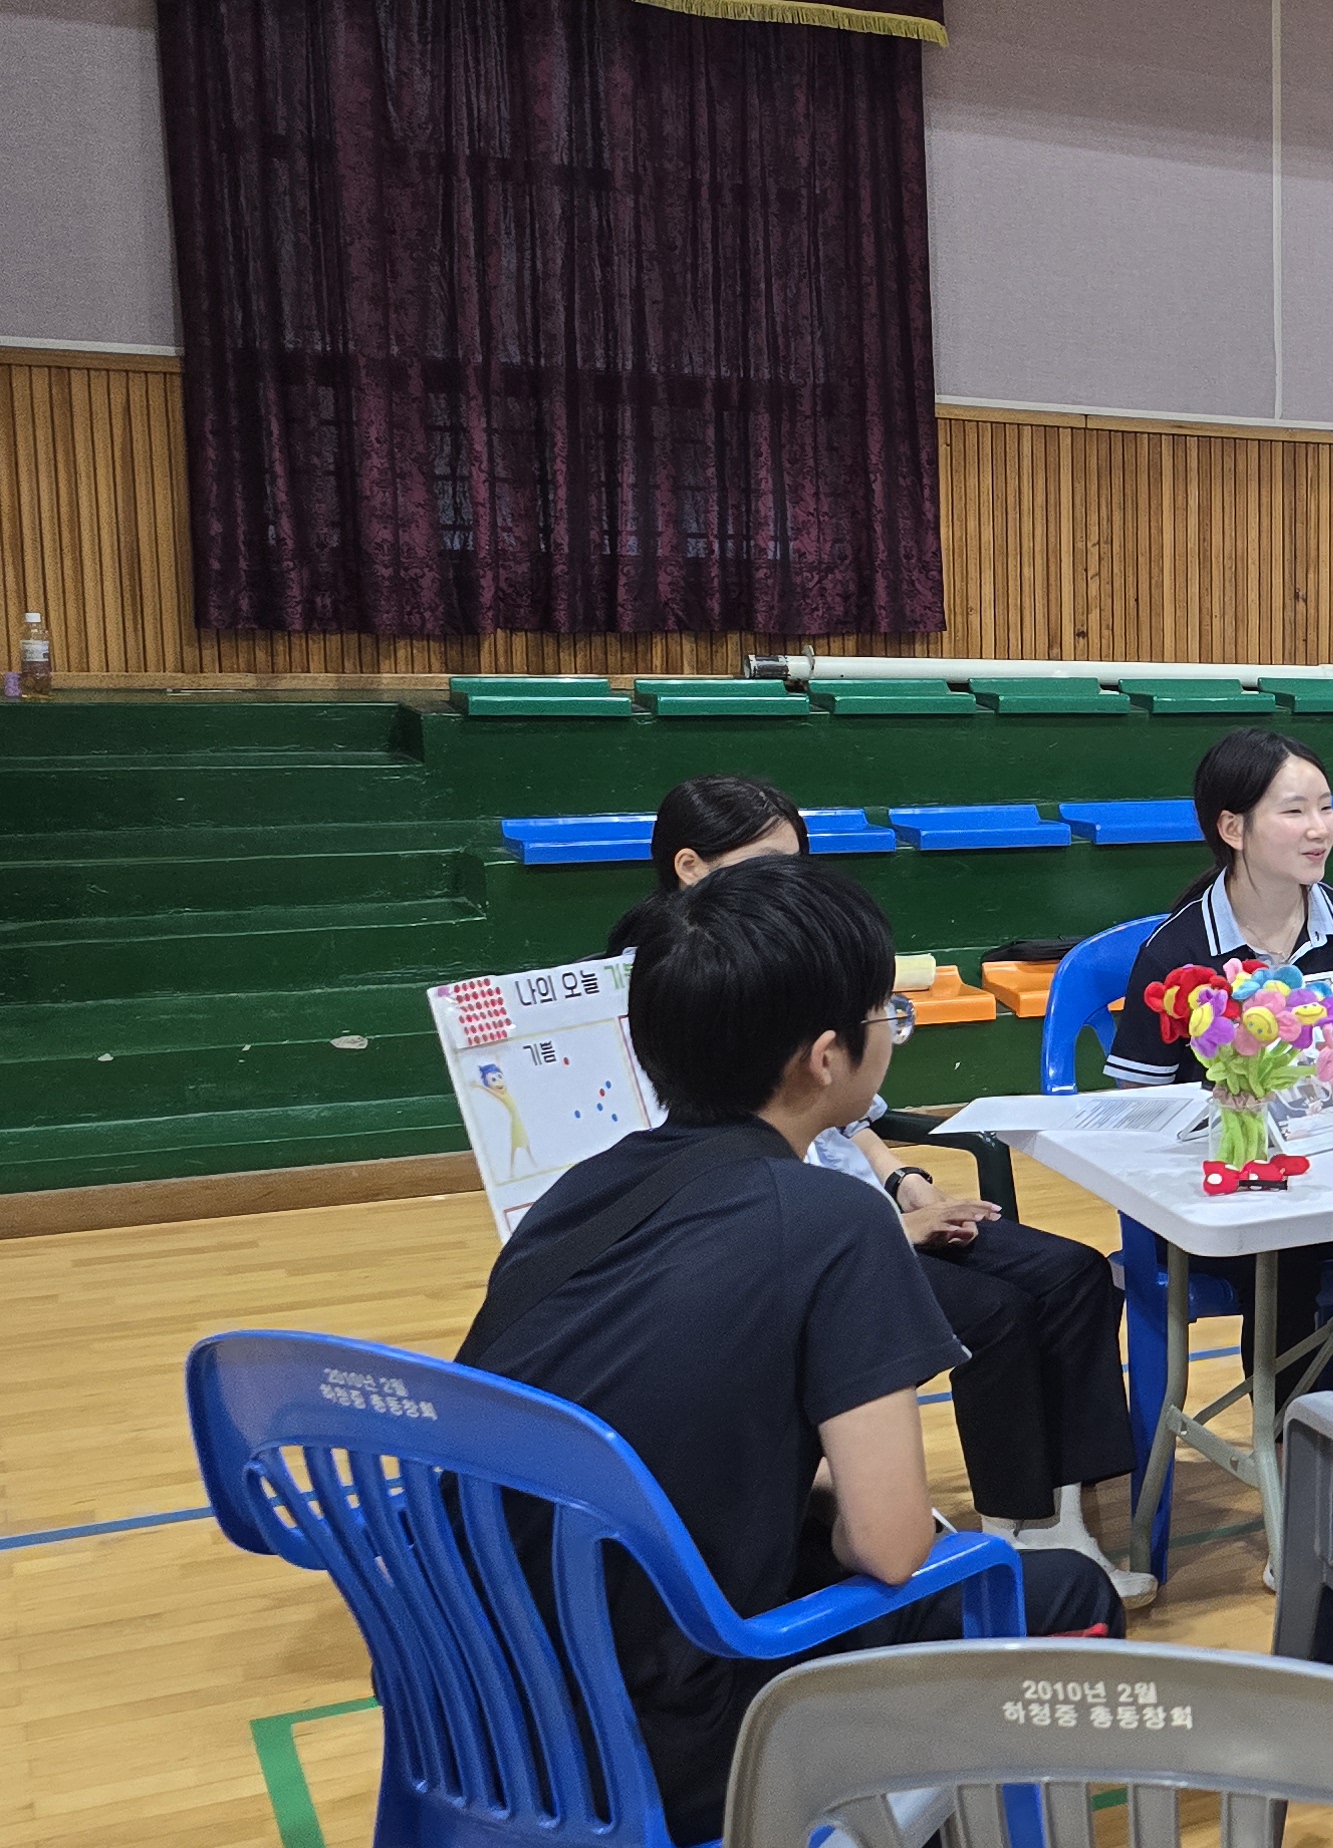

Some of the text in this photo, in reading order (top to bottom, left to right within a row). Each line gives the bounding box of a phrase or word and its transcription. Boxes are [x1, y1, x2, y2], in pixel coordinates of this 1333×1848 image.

[515, 975, 557, 1006] 나의
[562, 970, 600, 999] 오늘
[523, 1041, 557, 1066] 기쁨
[1022, 1680, 1158, 1705] 2010년 2월
[1002, 1701, 1194, 1730] 하청중 총동창회
